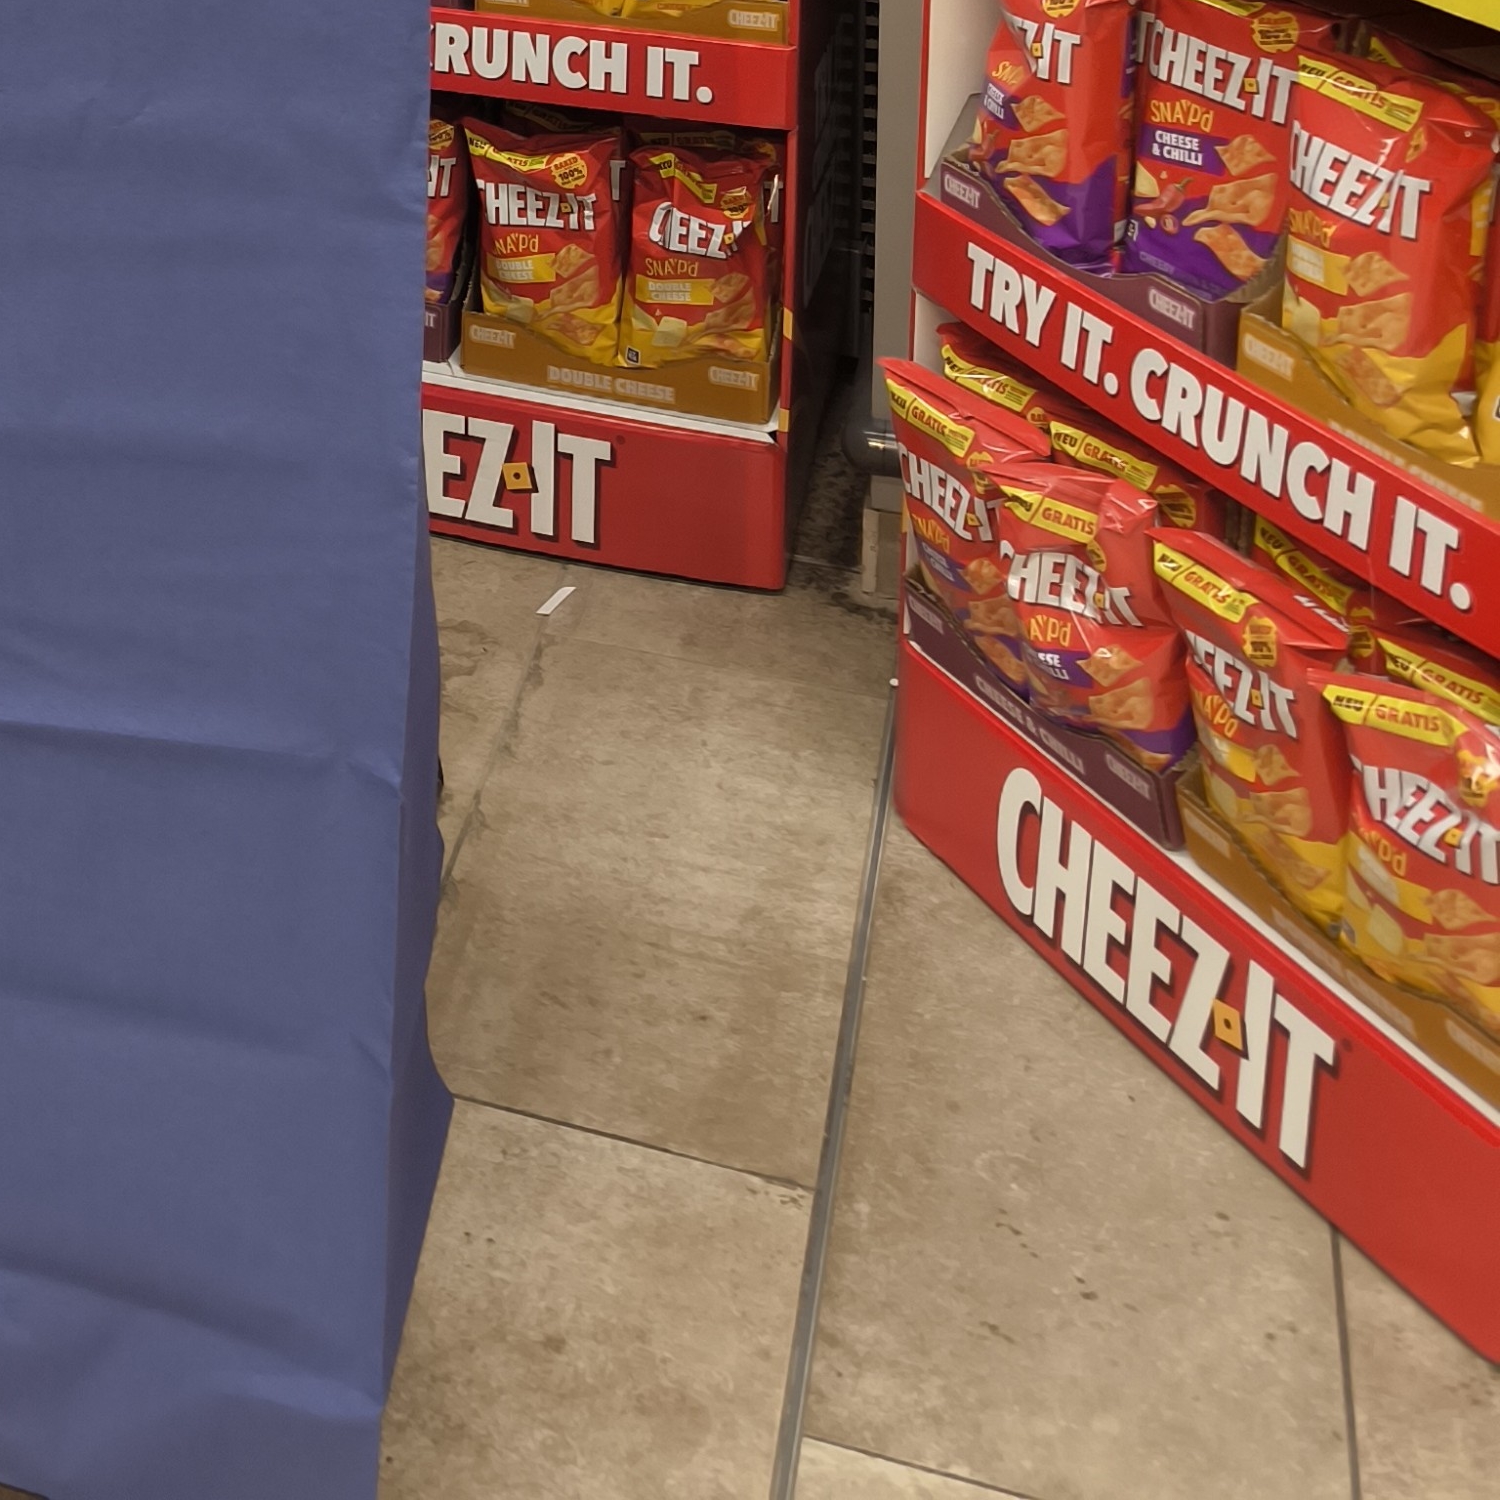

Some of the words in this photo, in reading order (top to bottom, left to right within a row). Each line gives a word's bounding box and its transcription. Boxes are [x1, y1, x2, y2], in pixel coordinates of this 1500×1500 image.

[430, 23, 628, 94] RUNCH
[646, 47, 714, 104] IT.
[1151, 142, 1161, 156] &
[1162, 145, 1203, 166] CHILLI
[1154, 130, 1200, 151] CHEESE
[558, 169, 584, 183] 100%
[650, 291, 692, 302] CHEESE
[546, 365, 612, 392] DOUBLE
[615, 377, 676, 402] CHEESE
[968, 242, 1057, 347] TRY
[1060, 308, 1119, 396] IT.
[1130, 348, 1376, 552] CRUNCH
[1390, 497, 1473, 611] IT.
[1041, 509, 1096, 537] GRATIS
[1421, 667, 1485, 705] GRATIS
[1374, 704, 1440, 732] GRATIS
